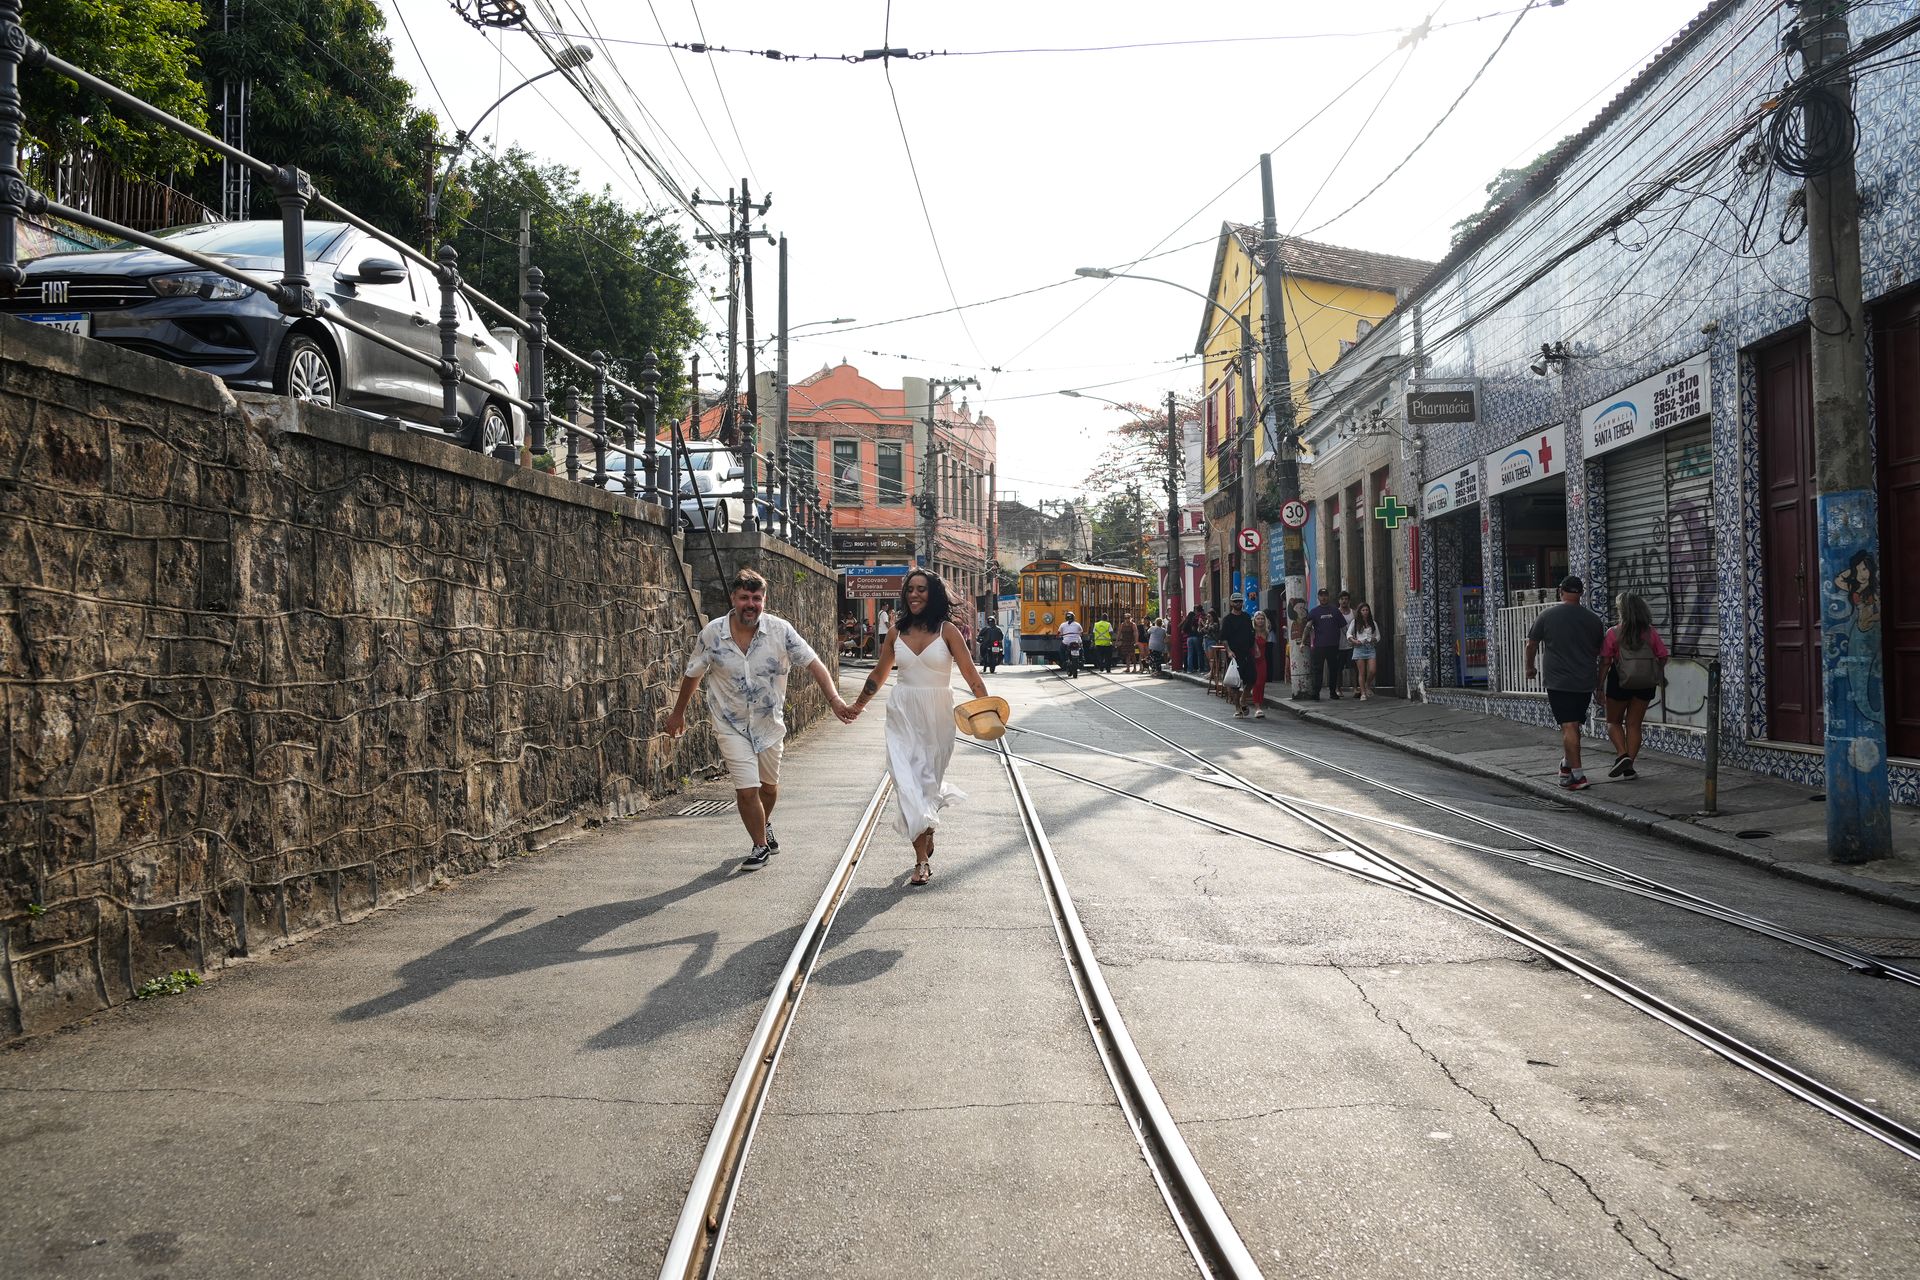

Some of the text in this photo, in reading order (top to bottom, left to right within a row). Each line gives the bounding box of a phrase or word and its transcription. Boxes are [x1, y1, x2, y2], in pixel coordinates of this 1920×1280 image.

[42, 281, 70, 303] FIAT
[1412, 397, 1470, 415] Pharmácia
[1654, 388, 1700, 417] 3852-3414
[1654, 402, 1701, 430] 99774-2709
[1594, 419, 1635, 447] SANTA TERESA
[1502, 464, 1532, 485] SANTA TERESA
[1286, 505, 1304, 519] 30
[1244, 533, 1255, 547] E
